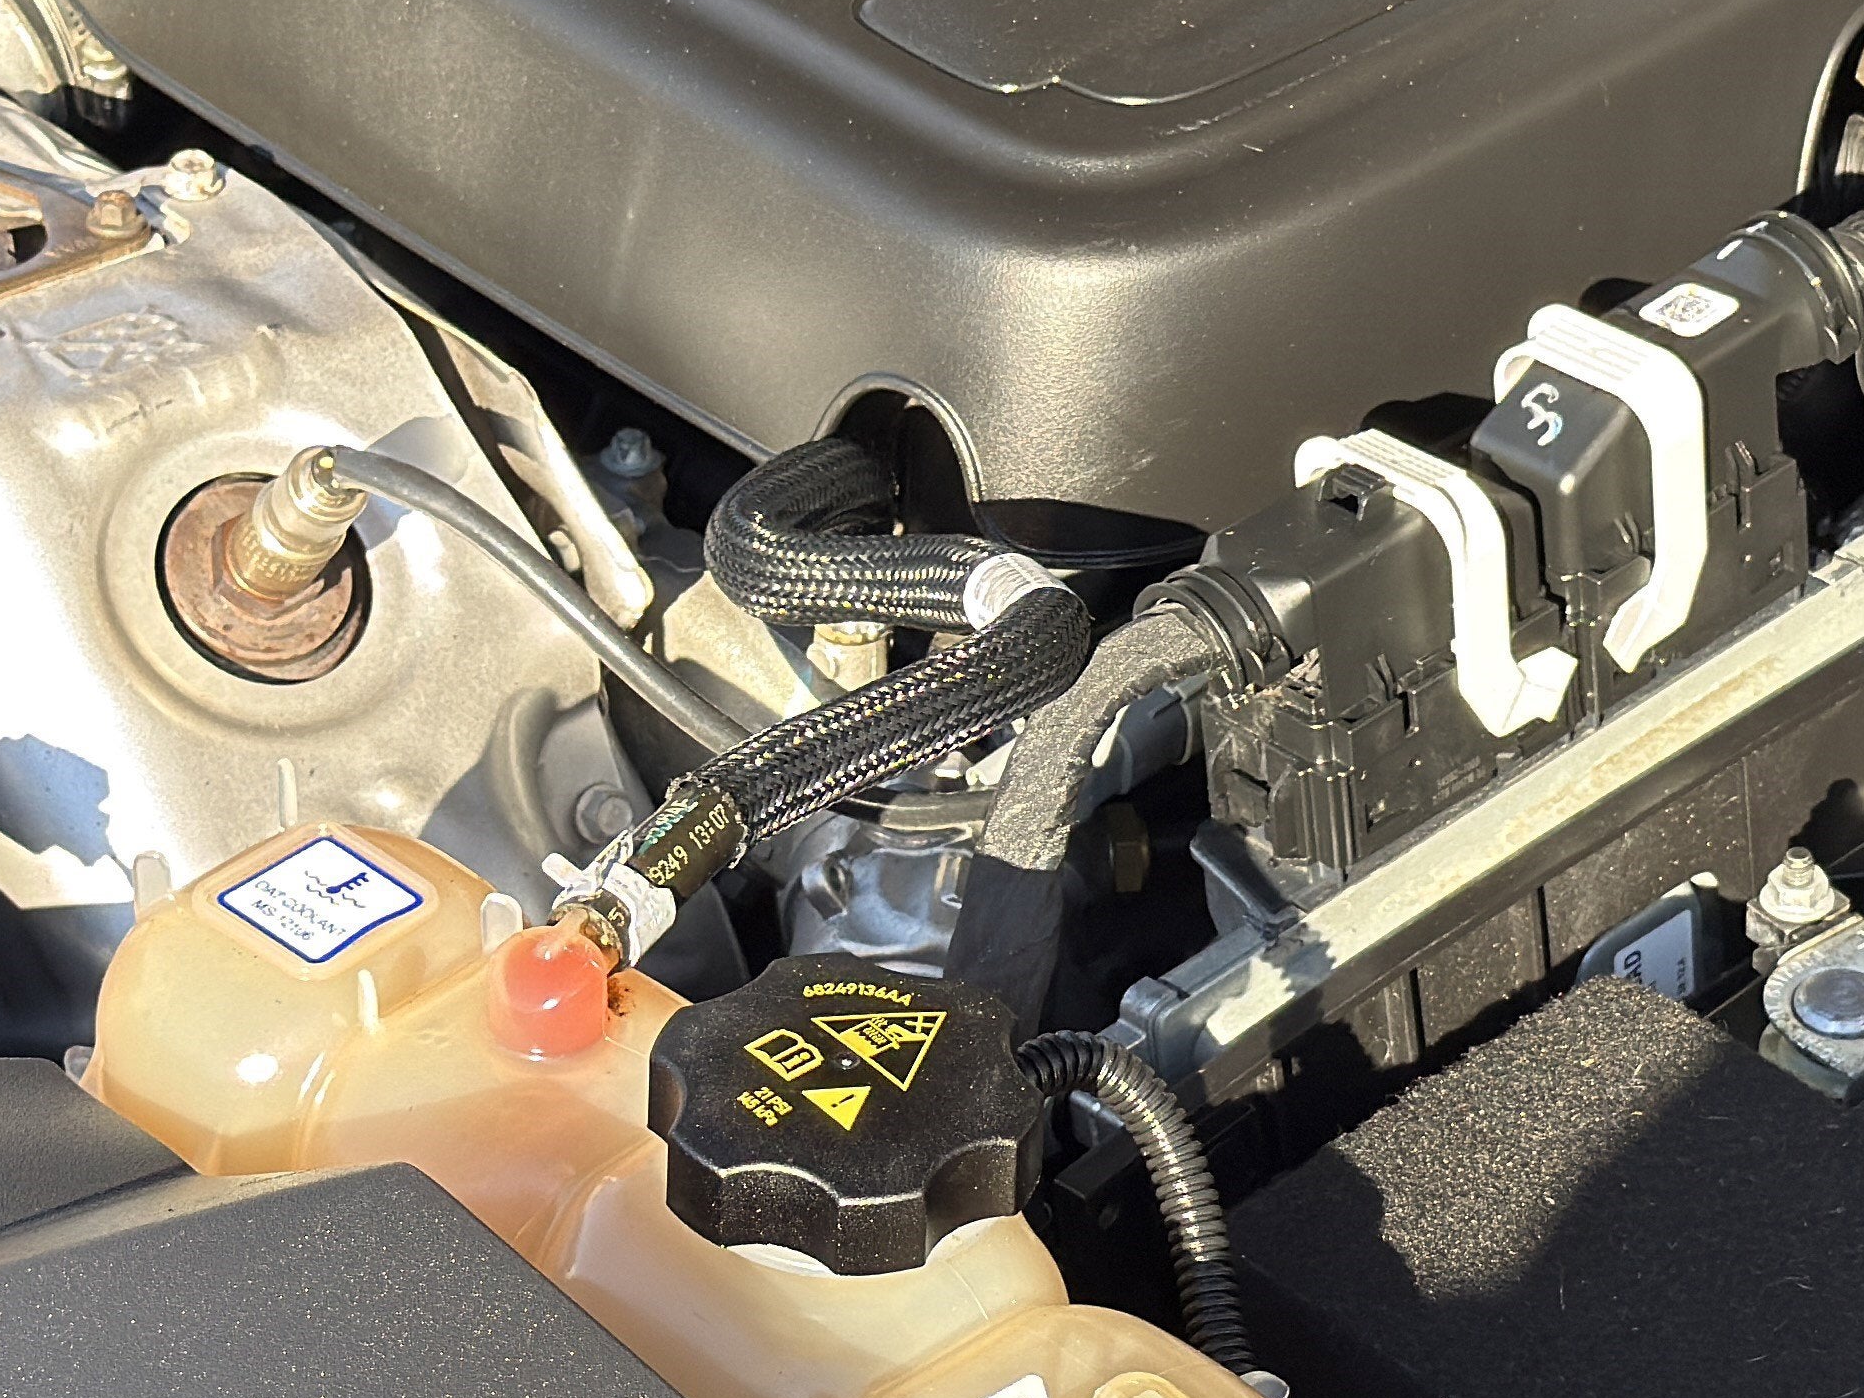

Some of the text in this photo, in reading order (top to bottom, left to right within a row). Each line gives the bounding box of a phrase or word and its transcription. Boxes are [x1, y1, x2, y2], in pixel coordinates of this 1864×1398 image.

[689, 803, 730, 850] 13:07
[802, 981, 913, 1007] 68249136AA
[769, 1093, 794, 1116] PSI
